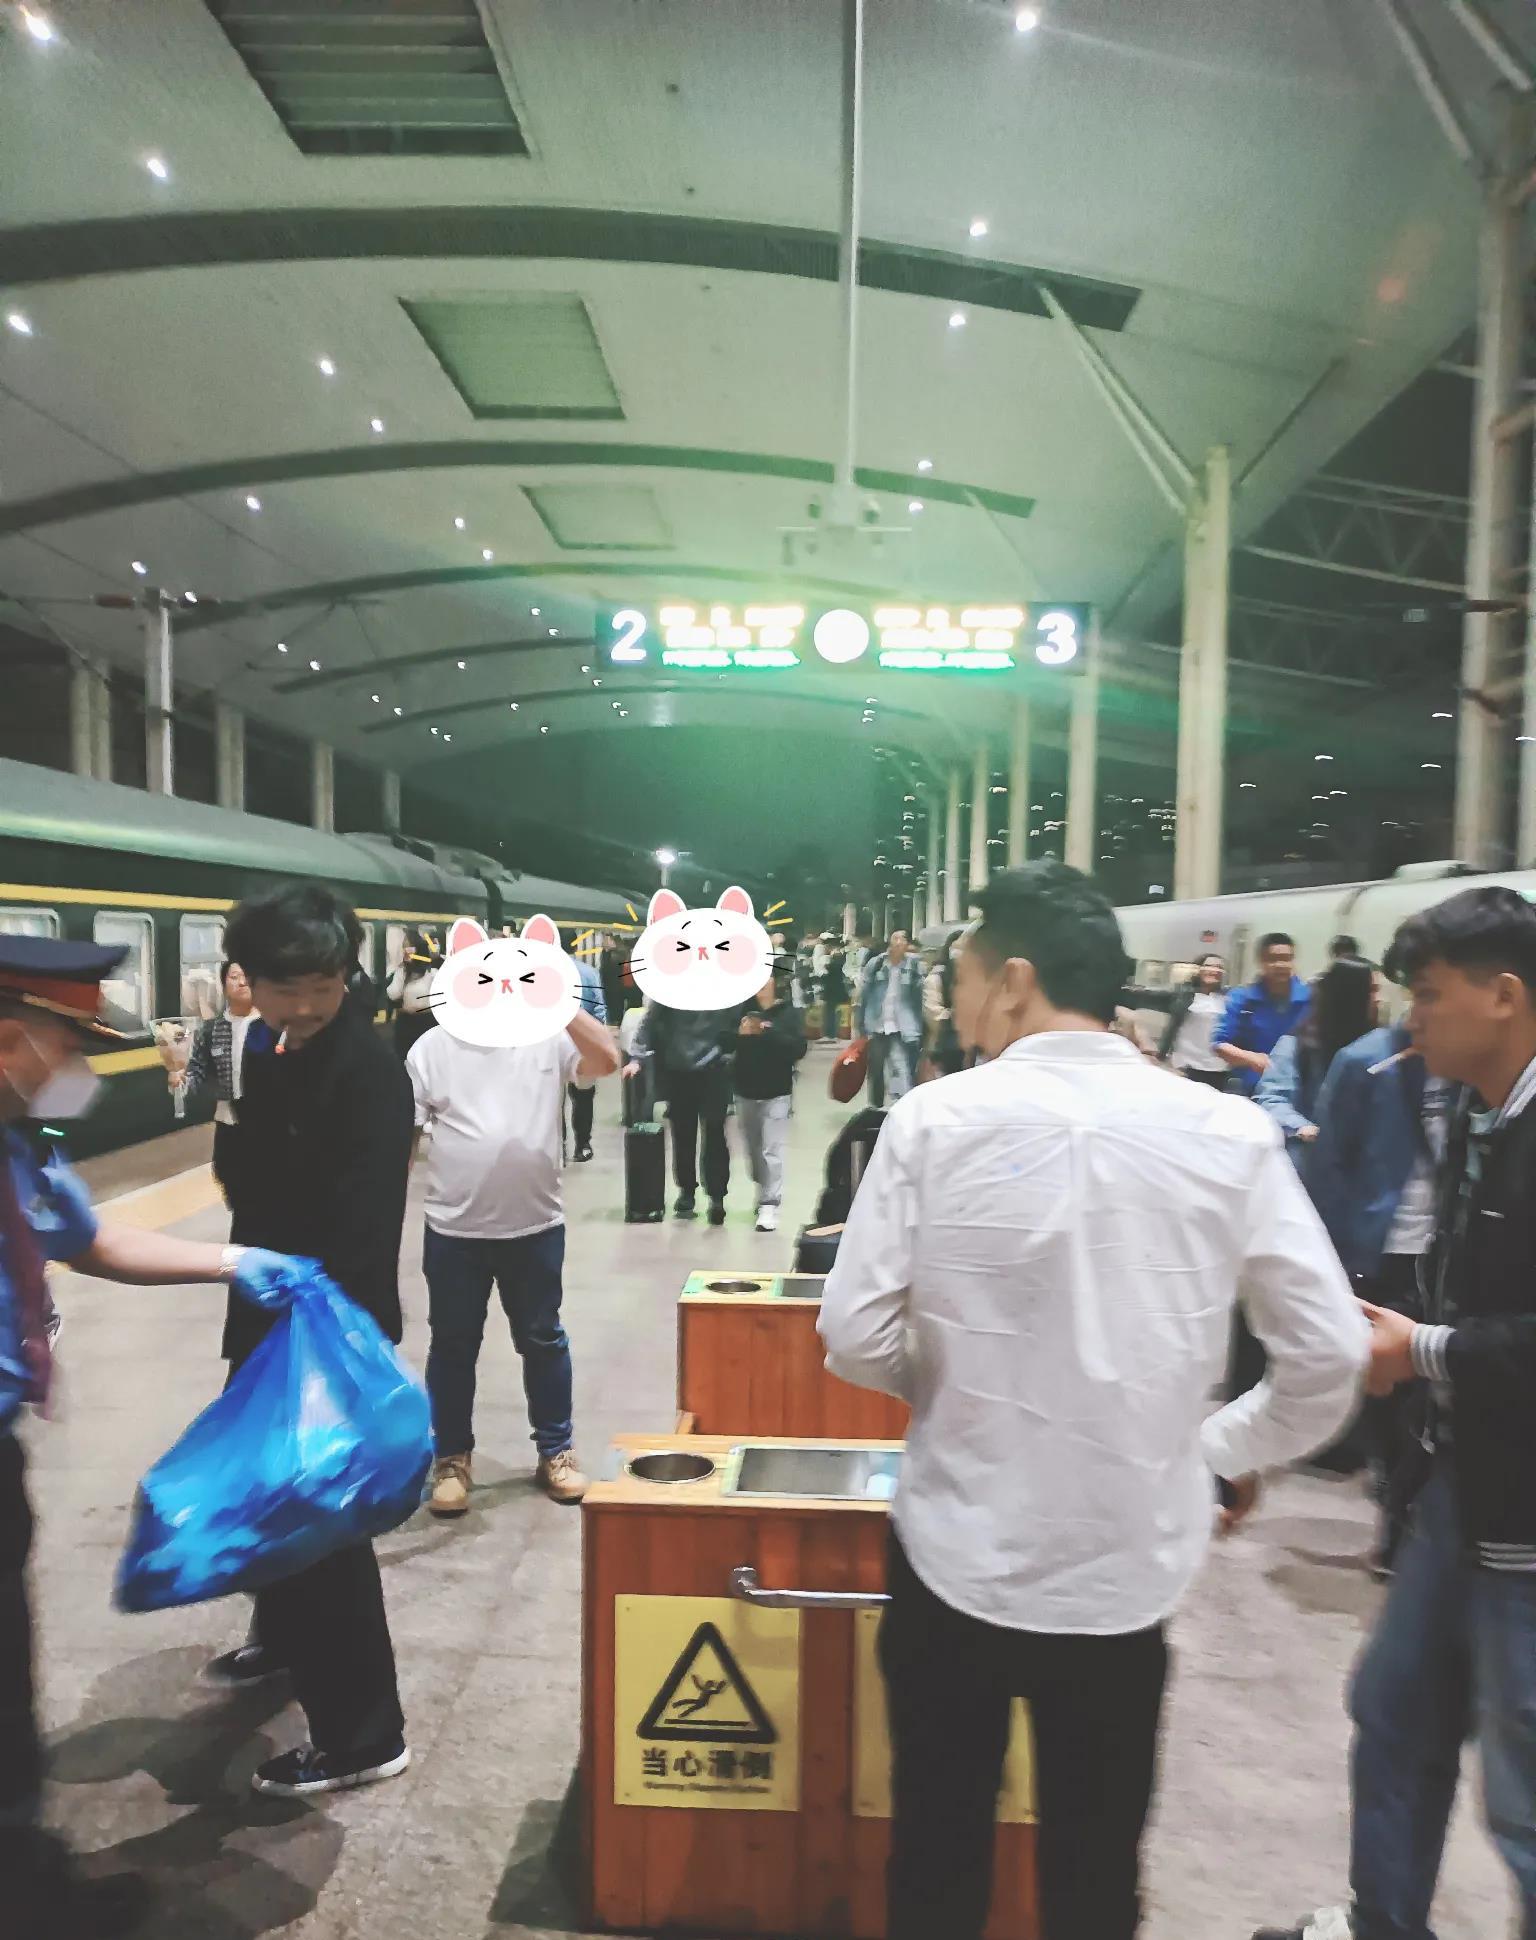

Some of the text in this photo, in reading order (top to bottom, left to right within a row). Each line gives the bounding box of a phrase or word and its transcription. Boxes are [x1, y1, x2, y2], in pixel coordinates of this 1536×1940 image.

[610, 609, 647, 661] 2
[1035, 612, 1077, 665] 3
[641, 1747, 774, 1780] 当心
